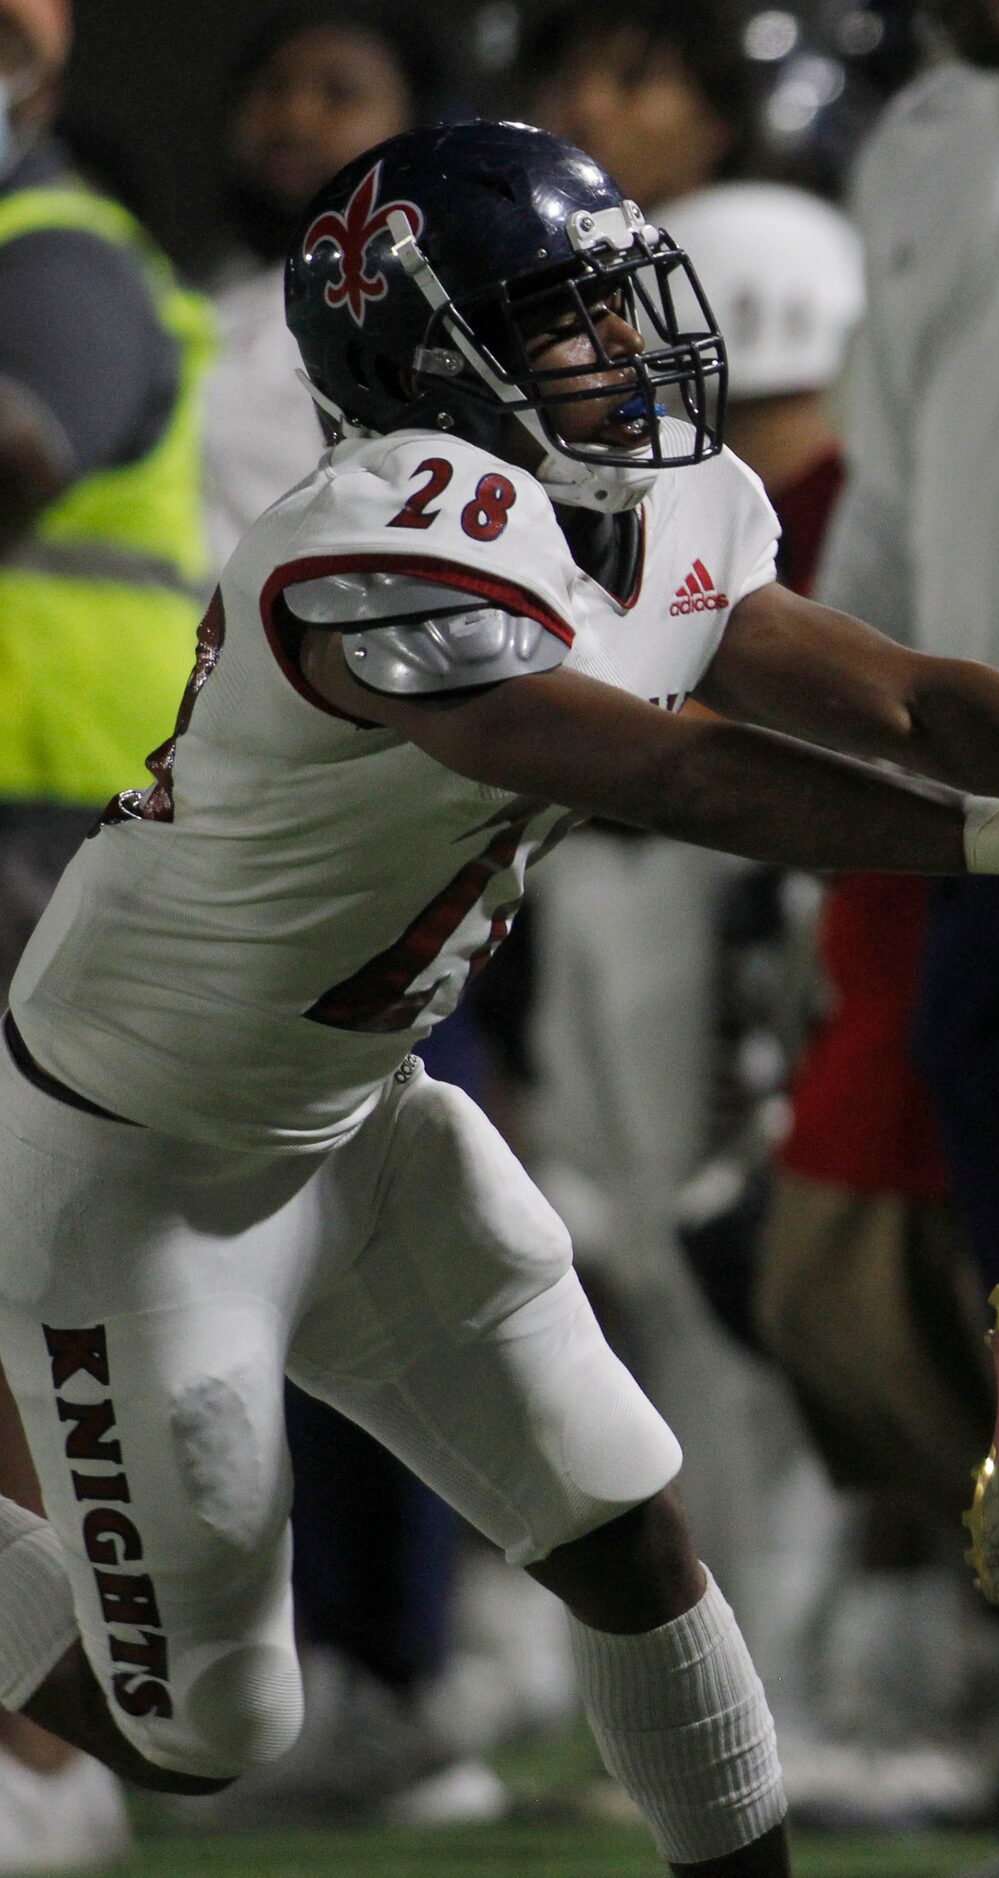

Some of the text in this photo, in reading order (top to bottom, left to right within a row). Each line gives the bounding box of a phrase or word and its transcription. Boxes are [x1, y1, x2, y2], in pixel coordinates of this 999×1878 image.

[386, 457, 517, 542] 28
[669, 593, 729, 616] adidas
[42, 1323, 174, 1720] KNIGHTS
